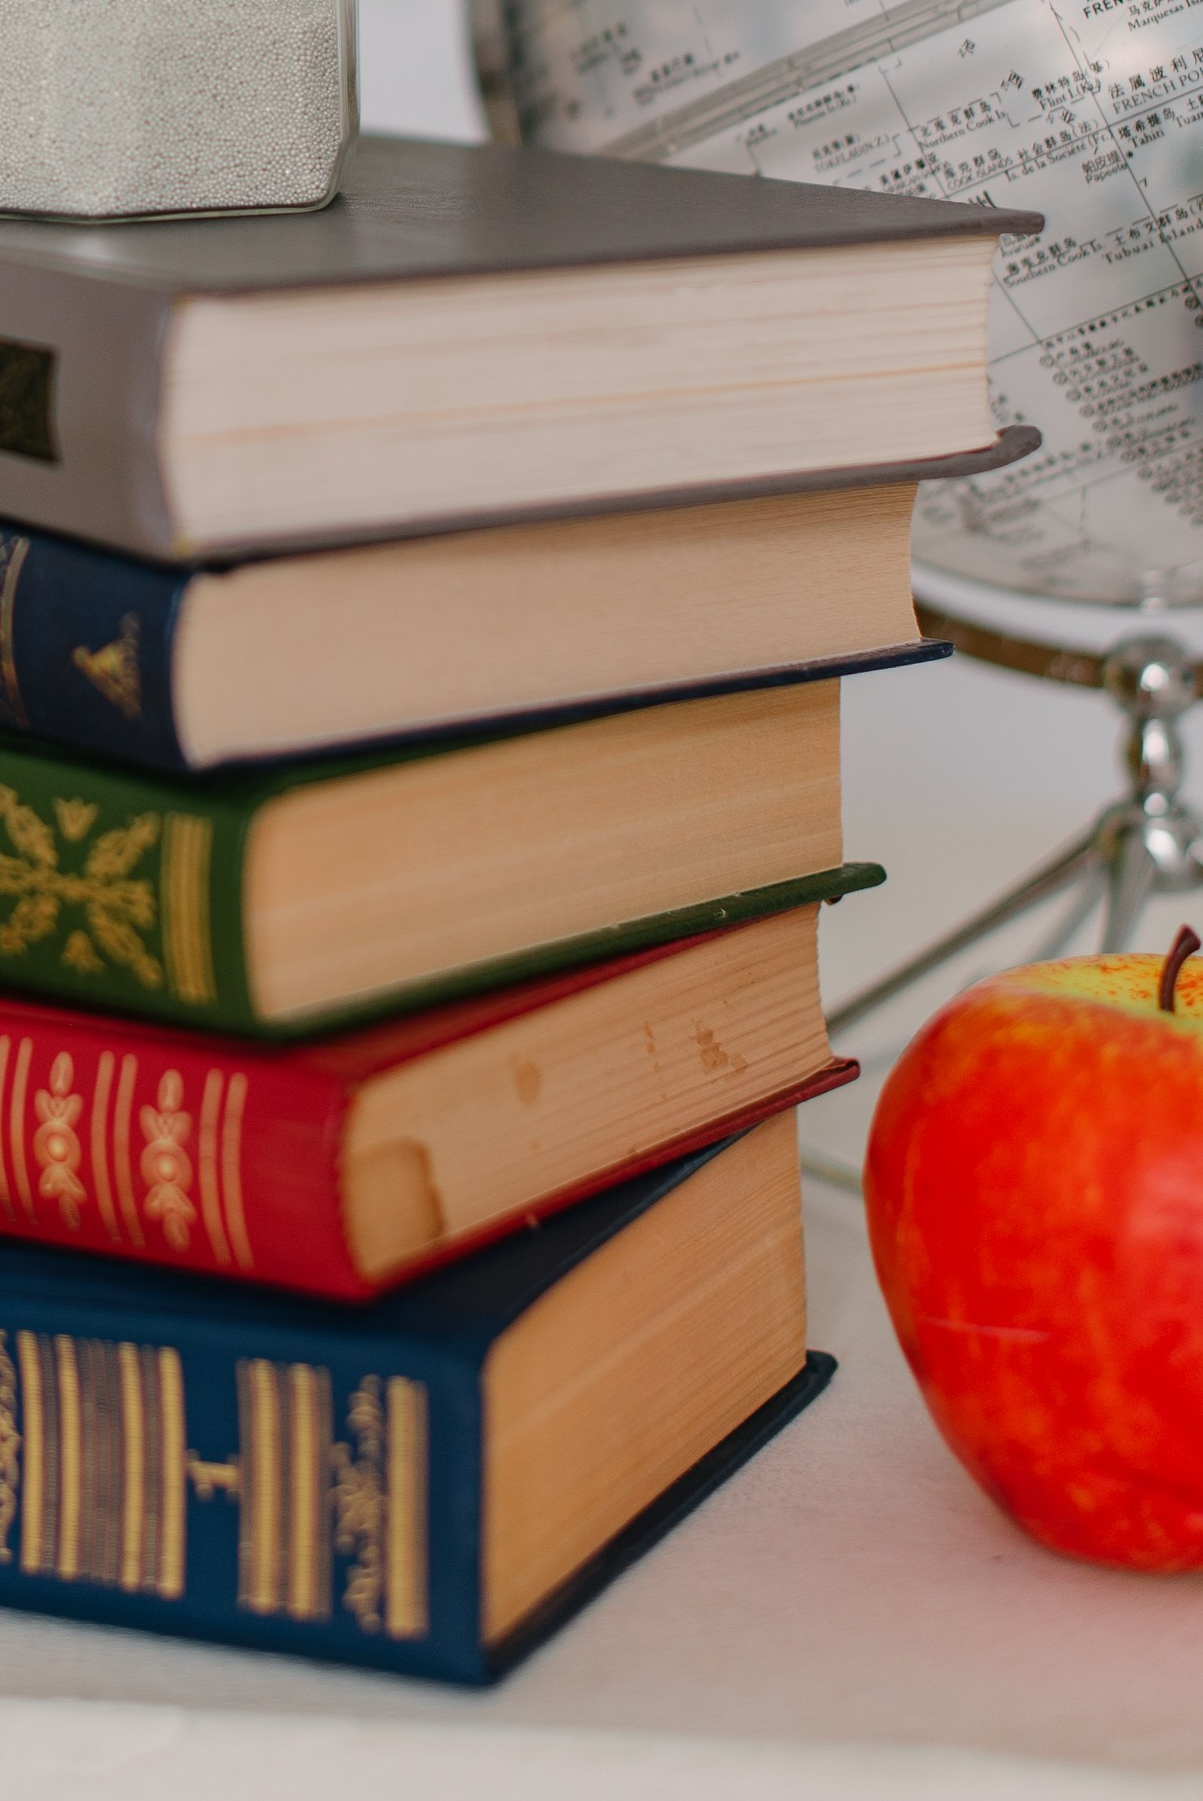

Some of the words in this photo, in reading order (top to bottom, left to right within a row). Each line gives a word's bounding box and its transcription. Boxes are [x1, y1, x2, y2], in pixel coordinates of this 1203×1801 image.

[1127, 4, 1185, 32] Marquesas
[1039, 93, 1068, 112] Flint
[1112, 81, 1178, 115] FRENCH
[917, 127, 967, 150] Northern
[965, 115, 996, 133] Cook
[1127, 127, 1166, 149] Tahiti
